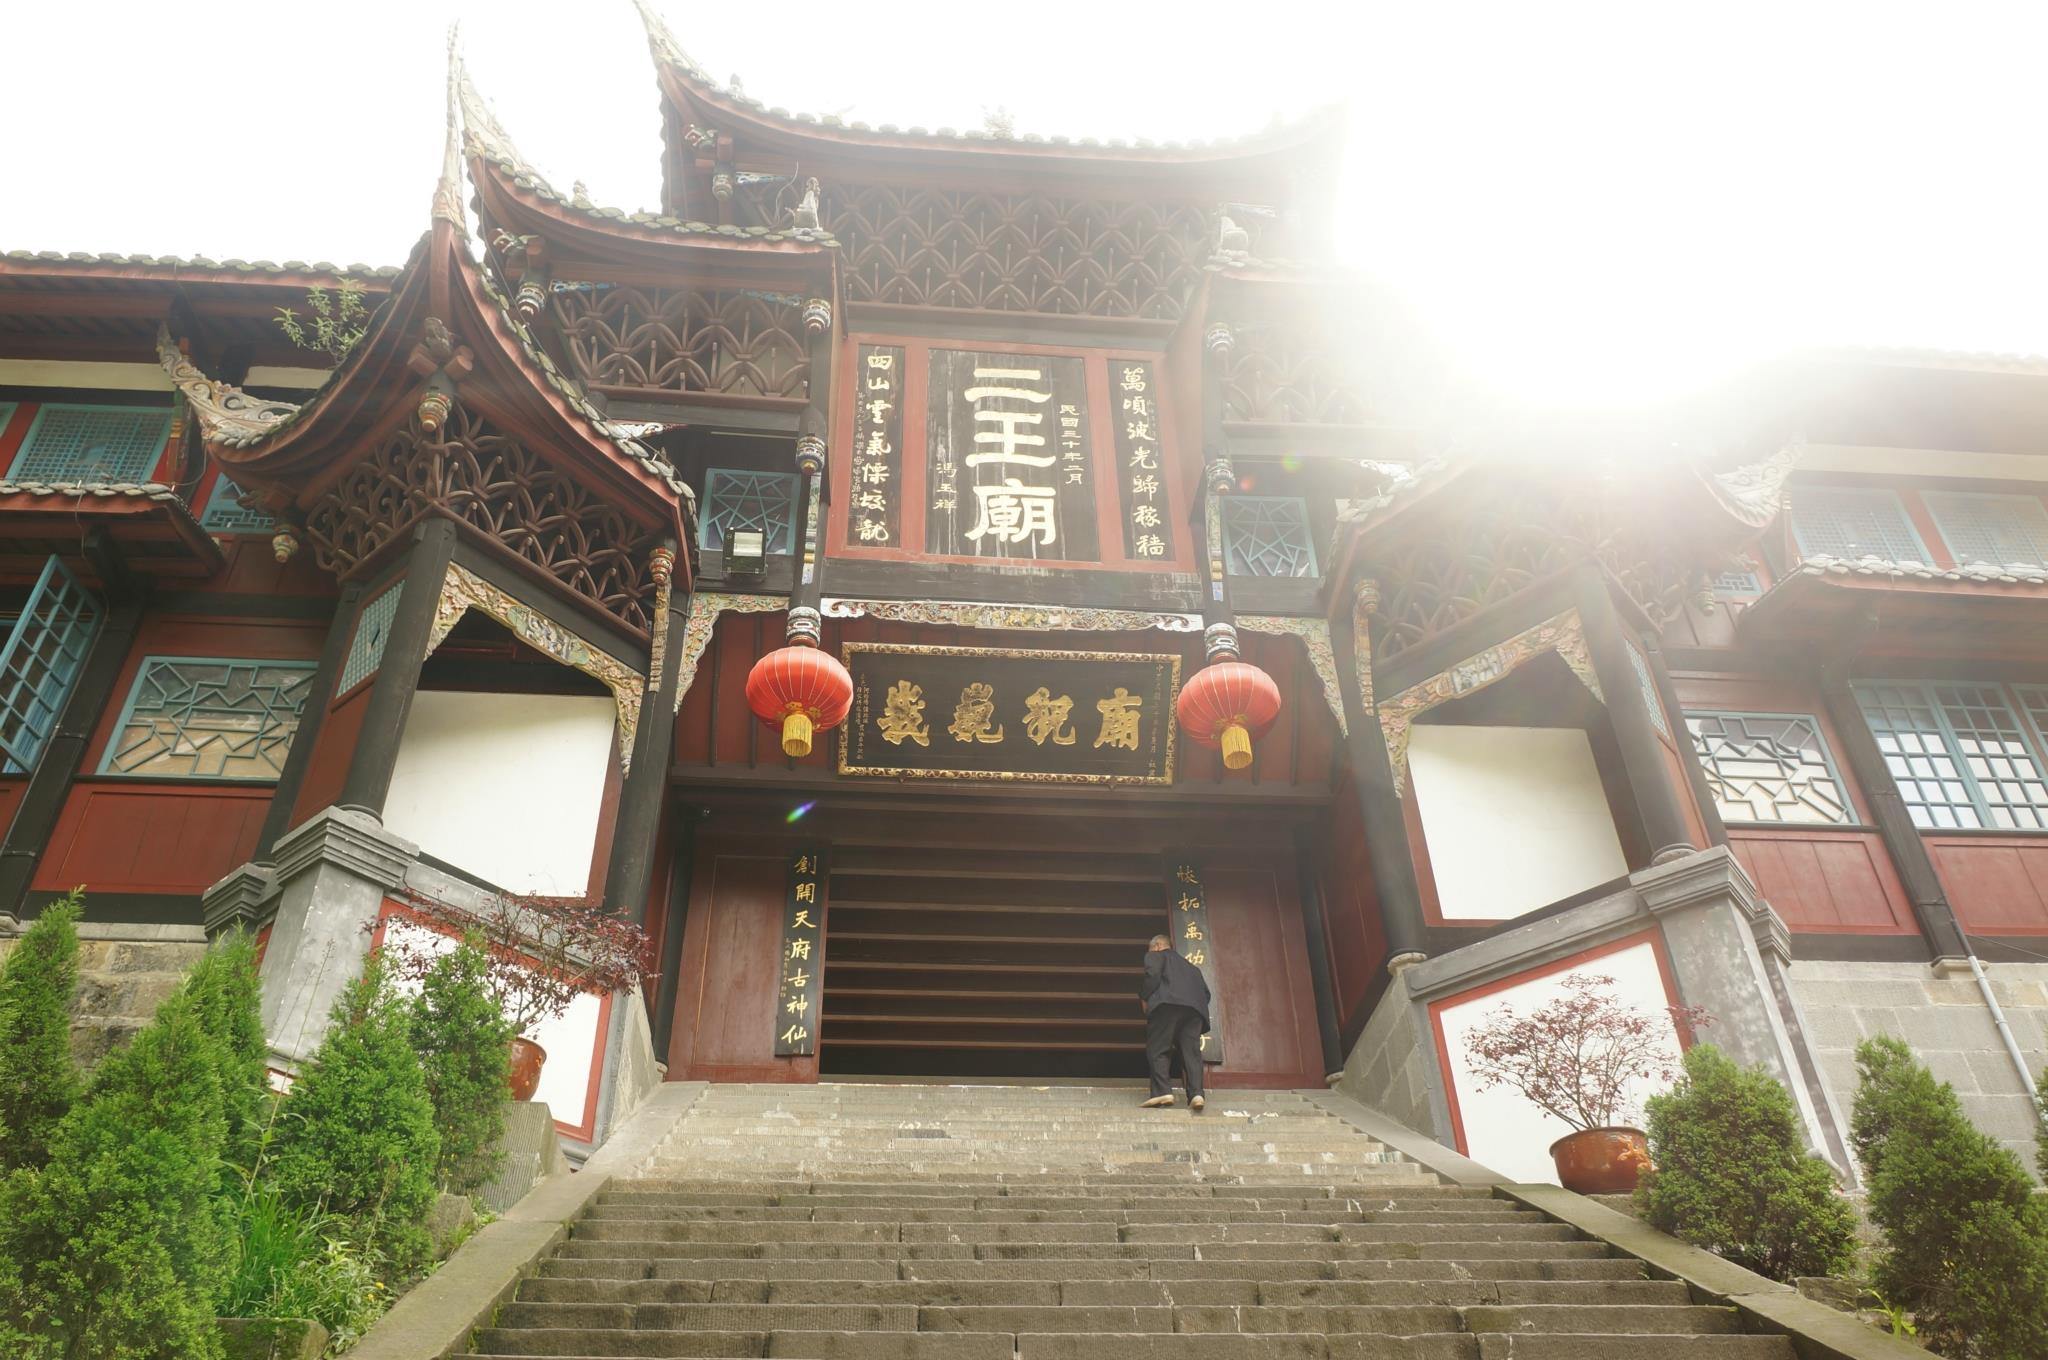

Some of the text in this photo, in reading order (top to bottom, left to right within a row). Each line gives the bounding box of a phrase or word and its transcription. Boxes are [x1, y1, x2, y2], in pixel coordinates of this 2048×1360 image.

[964, 367, 1057, 545] 二王廟
[1059, 403, 1085, 485] 民國三十年二月
[781, 855, 818, 1044] 創開天府古神仙
